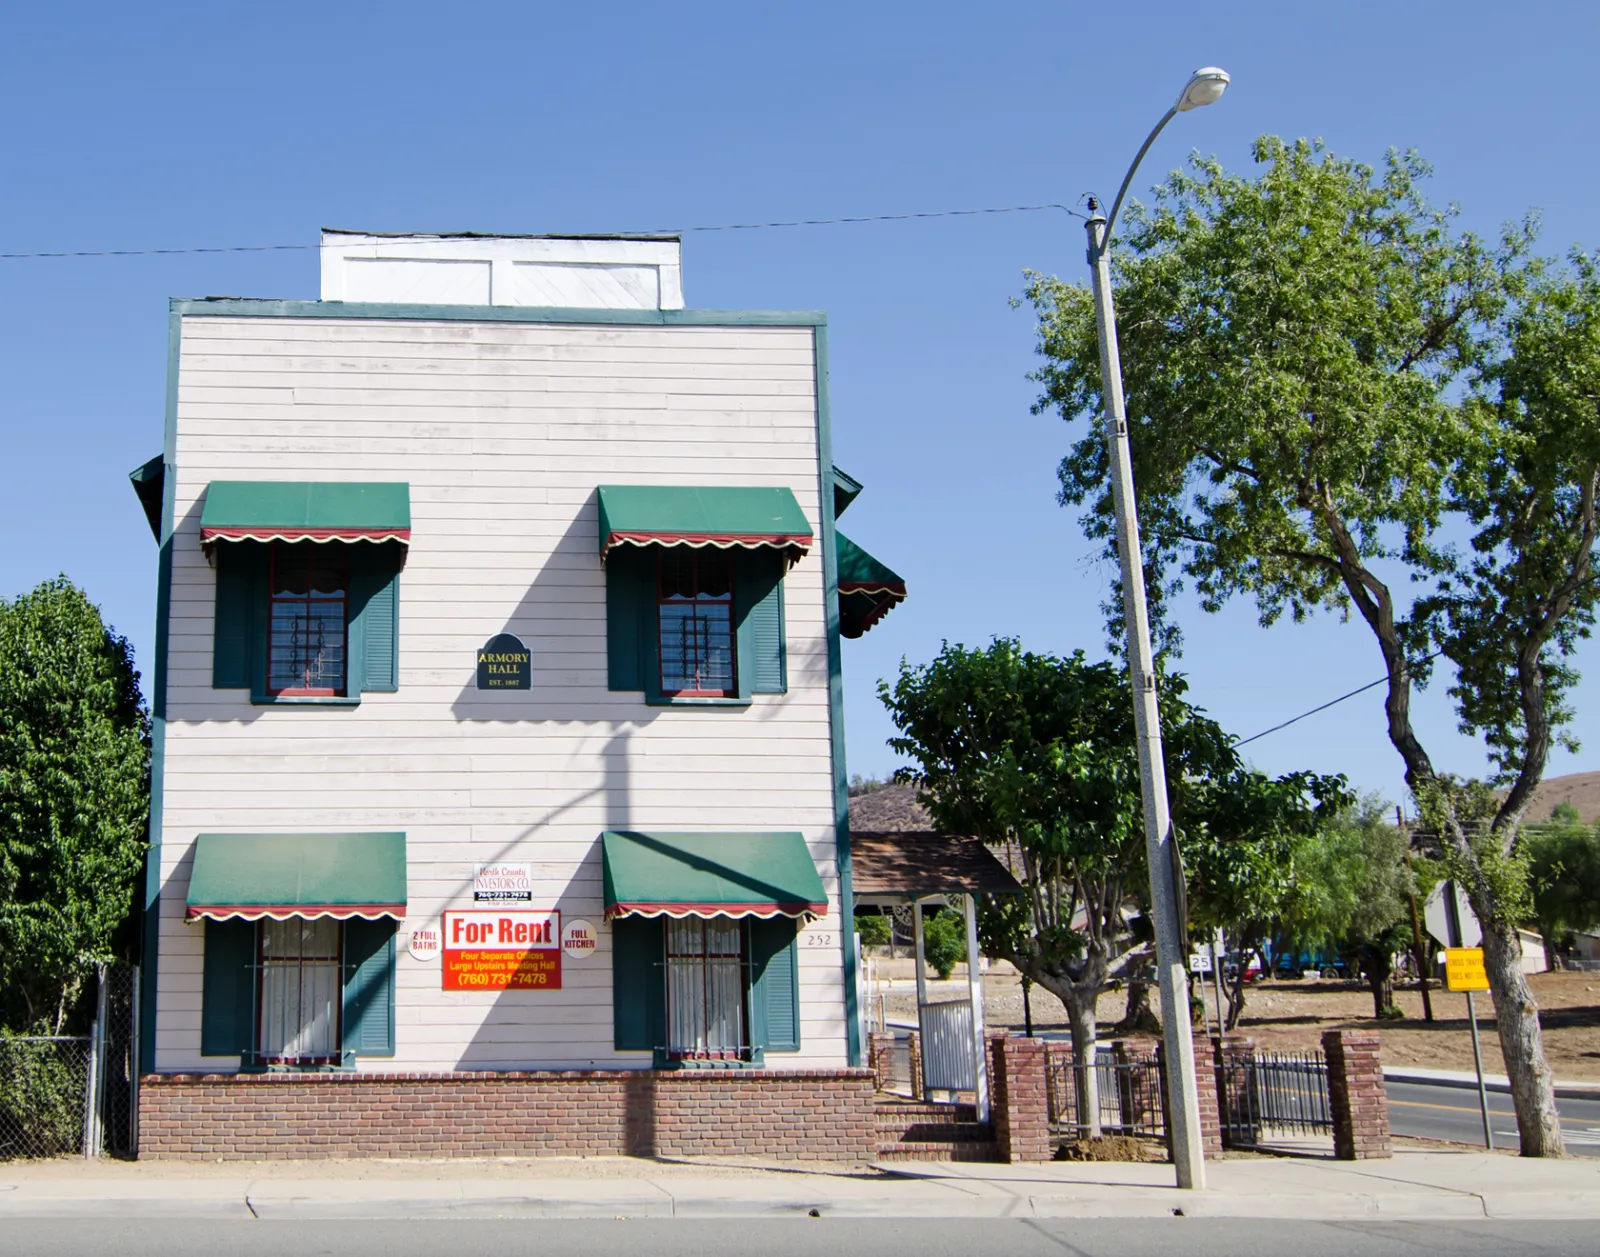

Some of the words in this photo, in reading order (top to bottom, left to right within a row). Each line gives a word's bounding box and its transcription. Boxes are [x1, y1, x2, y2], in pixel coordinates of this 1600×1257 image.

[479, 653, 529, 663] ARMORY
[488, 664, 520, 674] HALL
[480, 867, 499, 877] North
[501, 867, 526, 878] County
[475, 877, 515, 889] INVESTORS
[412, 931, 418, 940] 2
[420, 931, 437, 940] FULL
[452, 918, 494, 944] For
[498, 918, 552, 944] Rent
[571, 930, 588, 939] FULL
[412, 941, 437, 950] BATHS
[564, 939, 595, 949] KITCHEN
[808, 934, 831, 946] 252
[460, 951, 479, 960] Four
[480, 951, 515, 962] Separate
[516, 951, 544, 960] Offices
[449, 961, 473, 972] Large
[474, 961, 506, 972] Upstairs
[507, 961, 538, 972] Meeting
[540, 961, 556, 971] Hall
[1192, 957, 1209, 968] 25
[458, 973, 489, 985] (760)
[490, 973, 547, 984] 731-7478
